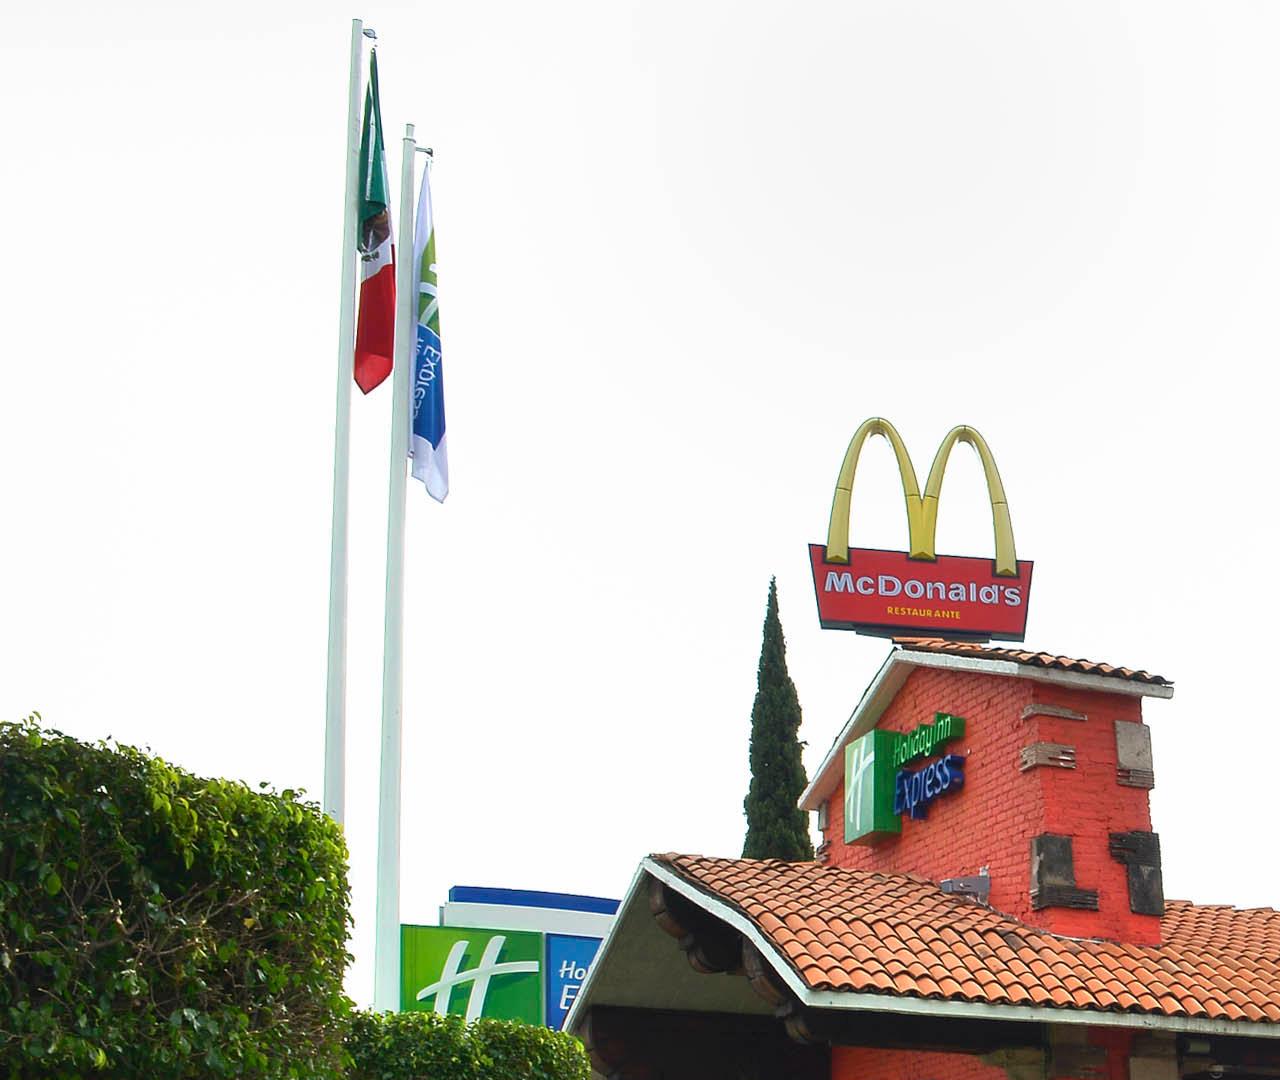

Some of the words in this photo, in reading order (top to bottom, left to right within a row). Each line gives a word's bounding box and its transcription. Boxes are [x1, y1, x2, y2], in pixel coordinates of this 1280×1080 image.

[825, 571, 1022, 607] McDonald's
[887, 606, 961, 620] RESTAURANTE
[893, 723, 933, 767] Holiday
[933, 715, 952, 745] Inn
[894, 754, 952, 820] Express
